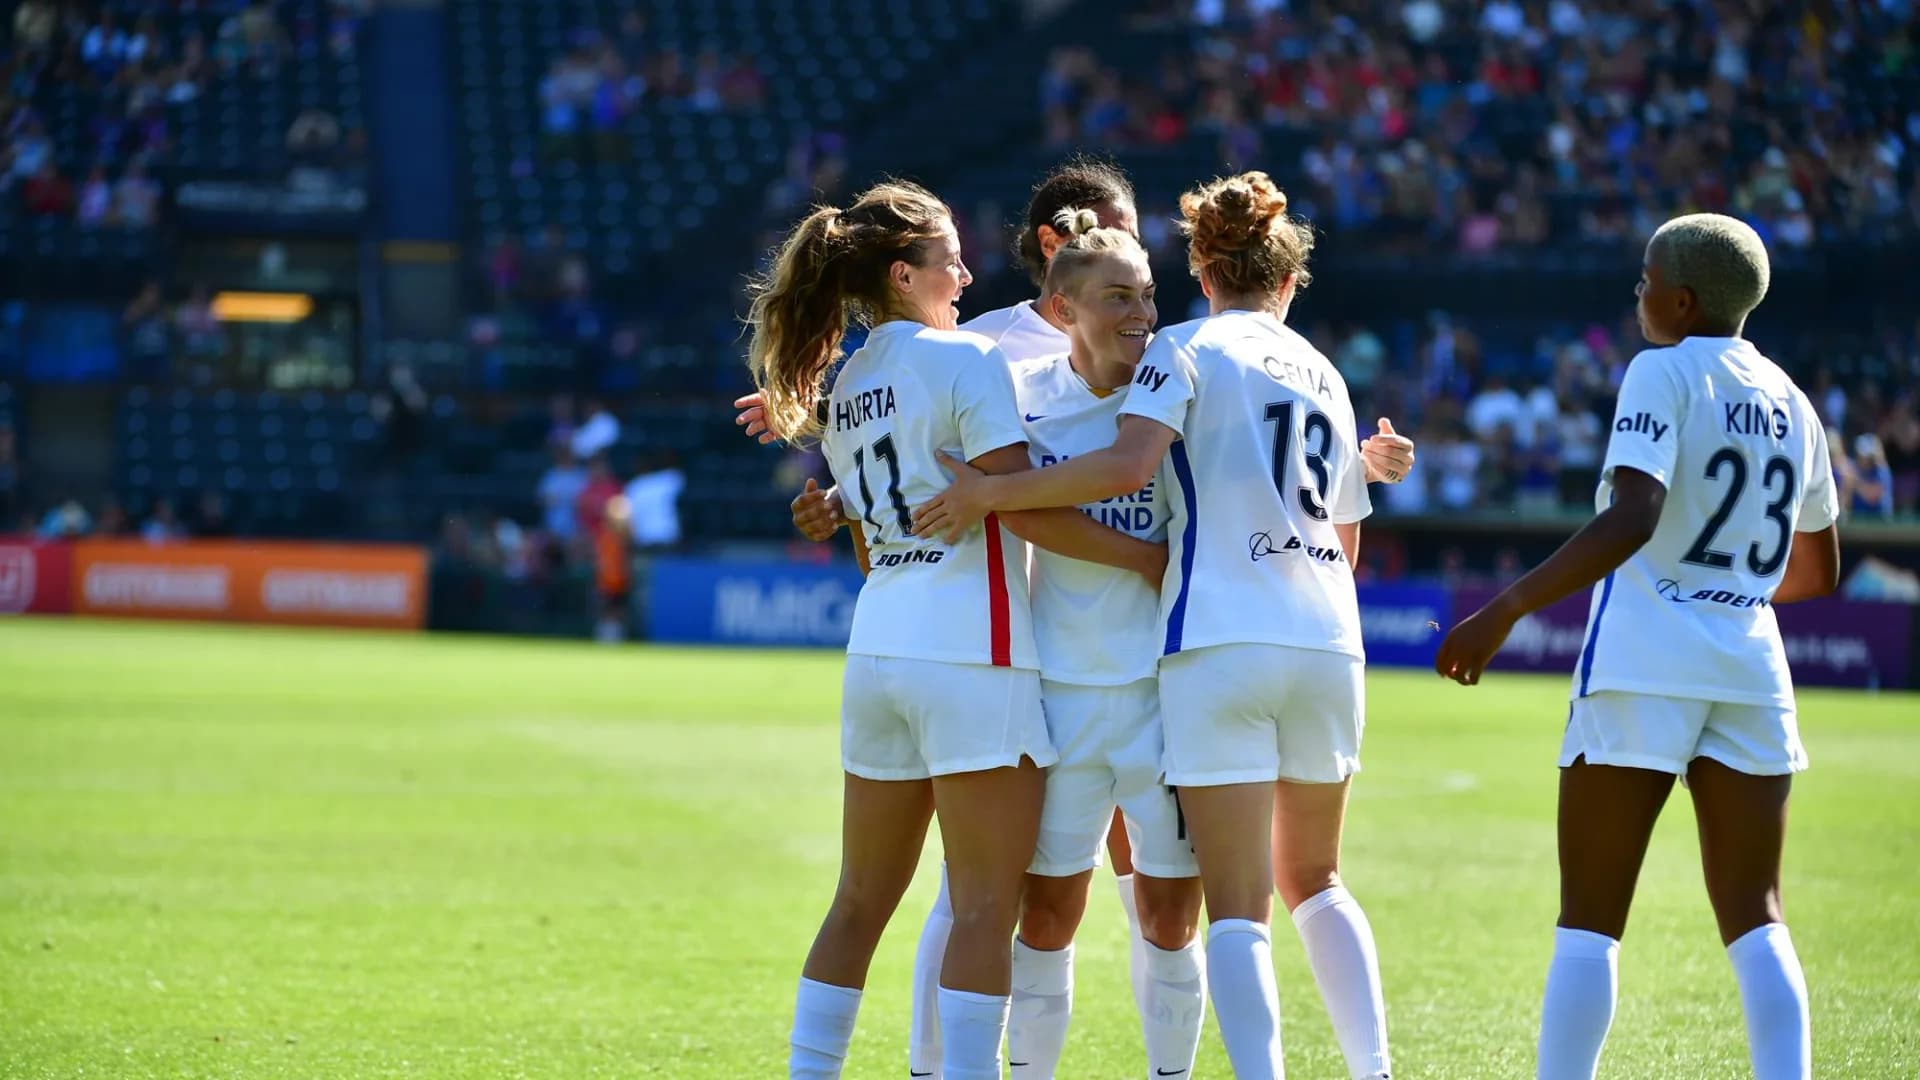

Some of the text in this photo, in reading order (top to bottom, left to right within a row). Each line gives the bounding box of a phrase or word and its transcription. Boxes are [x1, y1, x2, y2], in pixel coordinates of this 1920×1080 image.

[1135, 365, 1170, 392] lly
[1616, 412, 1668, 442] ally
[1725, 402, 1788, 440] KING
[1264, 400, 1332, 521] 13
[853, 432, 915, 544] 11
[1679, 446, 1796, 578] 23
[1689, 590, 1768, 608] BOEIN
